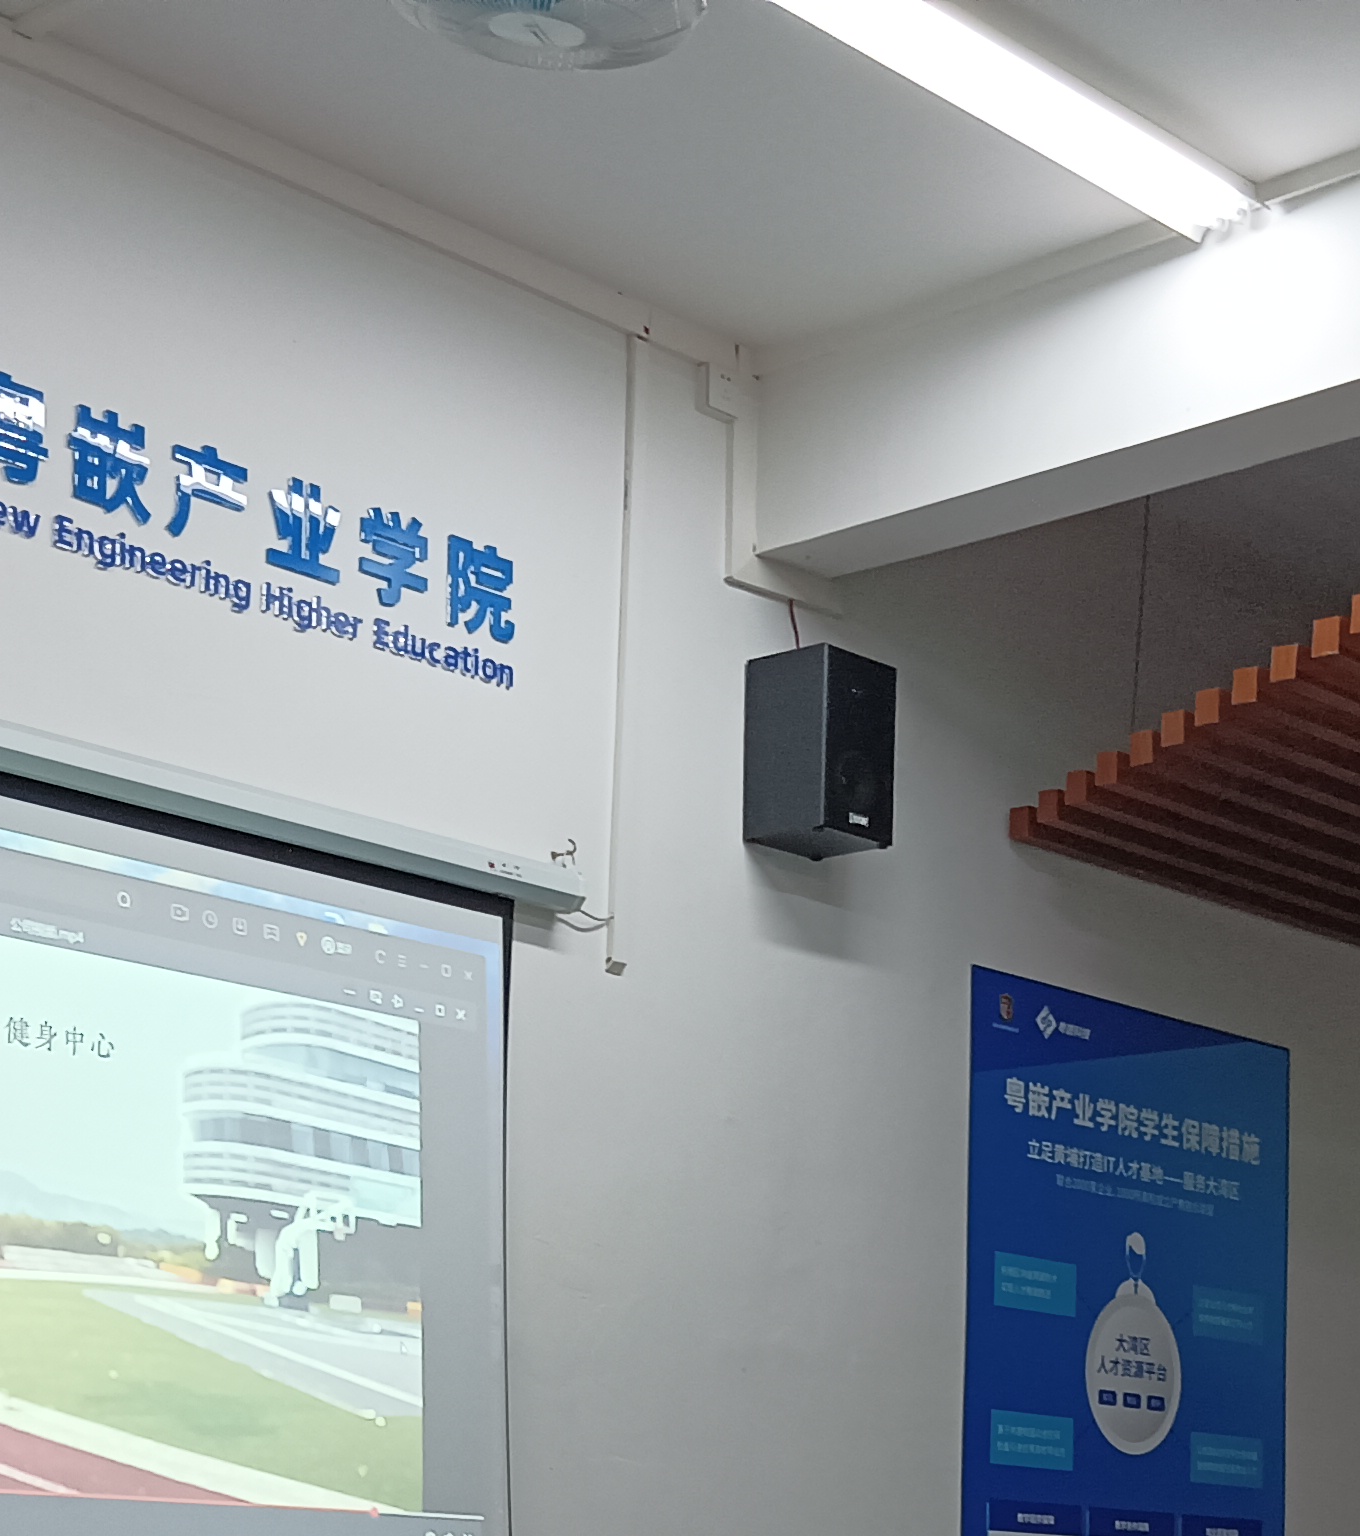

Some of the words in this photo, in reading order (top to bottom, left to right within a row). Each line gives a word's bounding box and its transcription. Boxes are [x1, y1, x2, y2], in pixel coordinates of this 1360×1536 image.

[51, 514, 251, 614] Engineering
[260, 582, 363, 639] Higher
[372, 617, 515, 690] Education
[1004, 1077, 1261, 1166] 粤嵌产业学院学生保障措施
[1096, 1354, 1167, 1383] 人才资源平台
